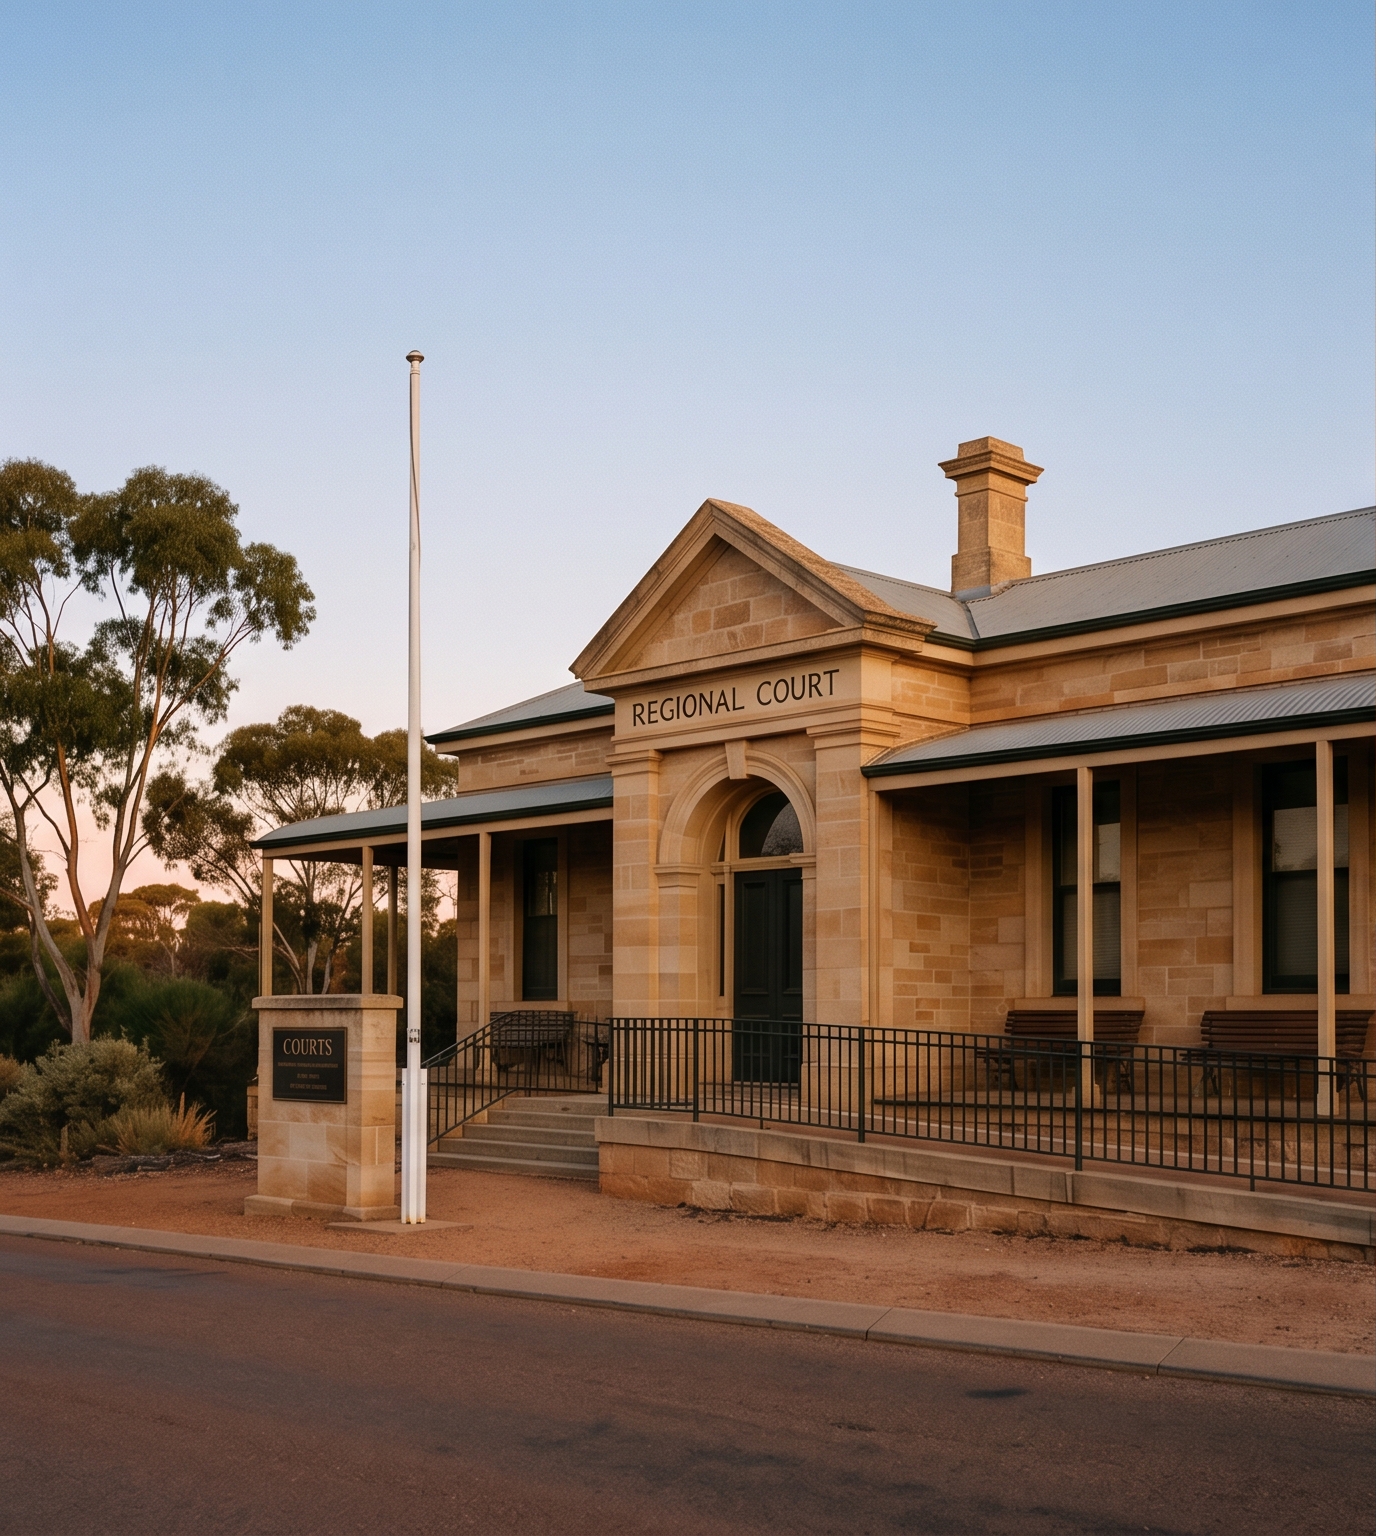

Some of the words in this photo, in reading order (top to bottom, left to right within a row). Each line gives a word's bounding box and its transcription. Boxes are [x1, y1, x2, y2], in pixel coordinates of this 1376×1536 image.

[632, 687, 745, 727] REGIONAL
[756, 668, 840, 706] COURT
[283, 1038, 333, 1056] COURTS
